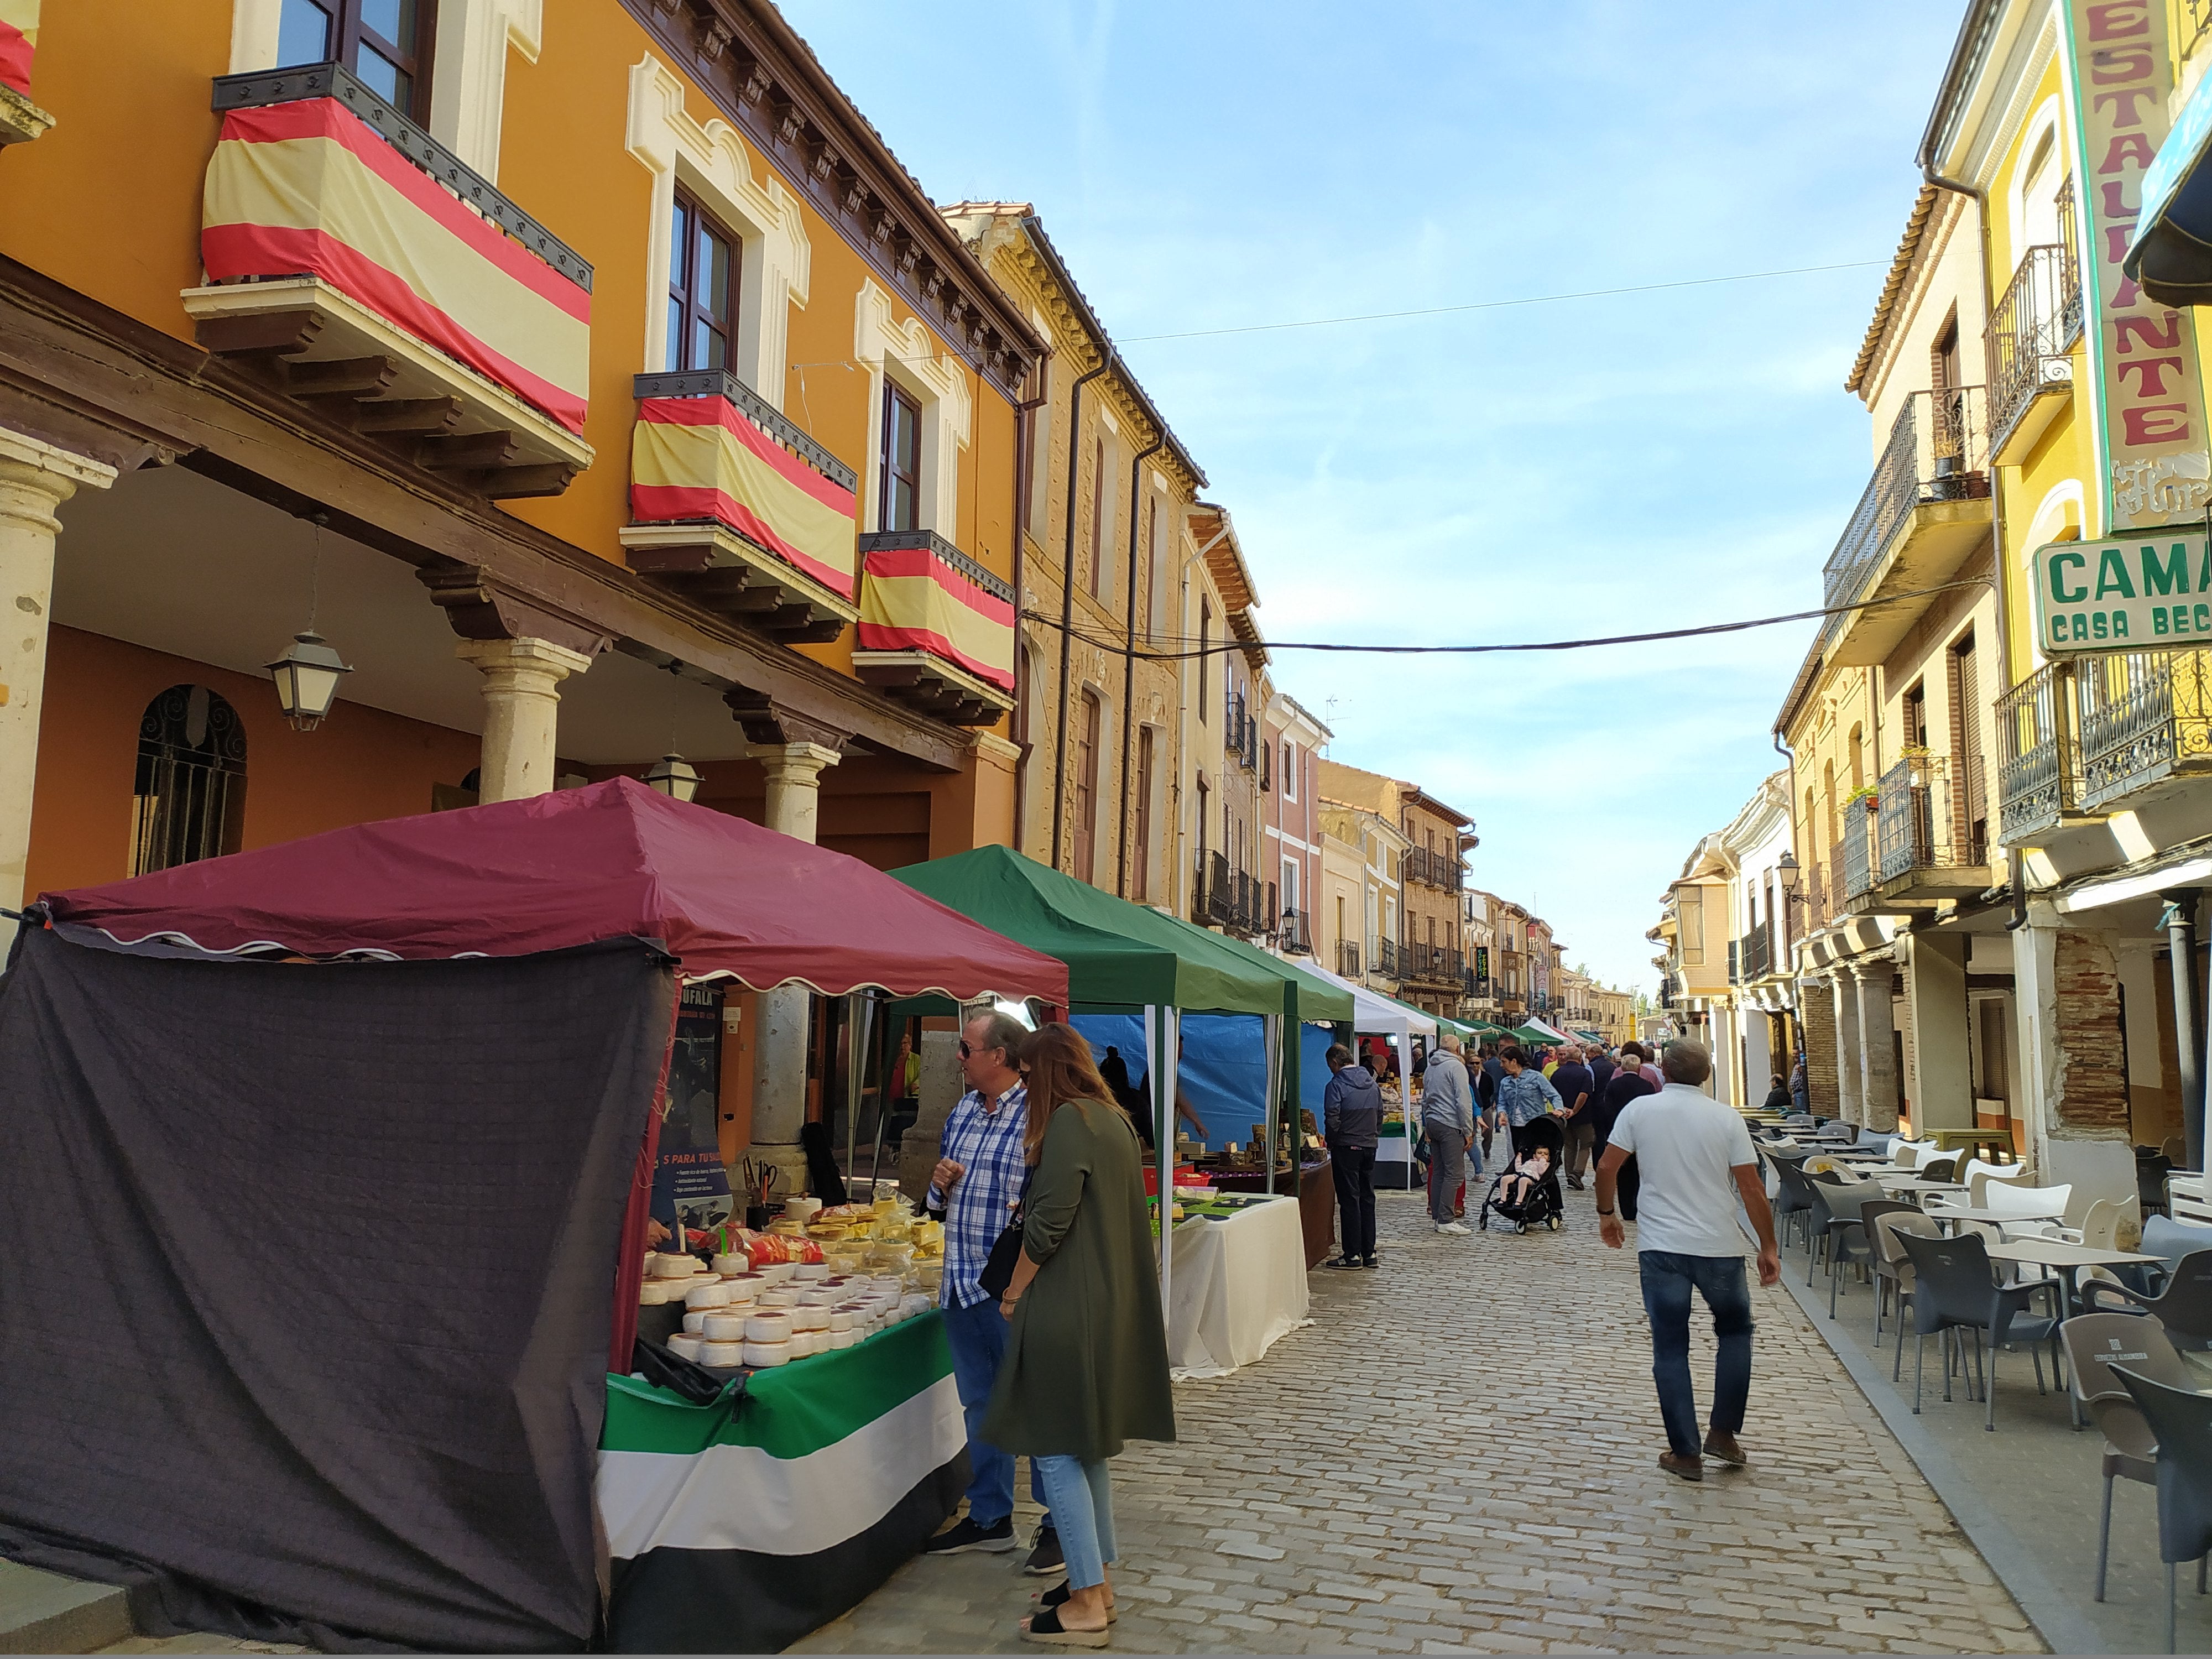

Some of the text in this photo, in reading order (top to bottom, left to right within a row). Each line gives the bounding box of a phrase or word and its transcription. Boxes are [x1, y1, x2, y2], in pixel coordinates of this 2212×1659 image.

[2052, 603, 2211, 643] CASA BEC
[671, 1154, 696, 1164] PARA
[698, 1153, 708, 1163] TU
